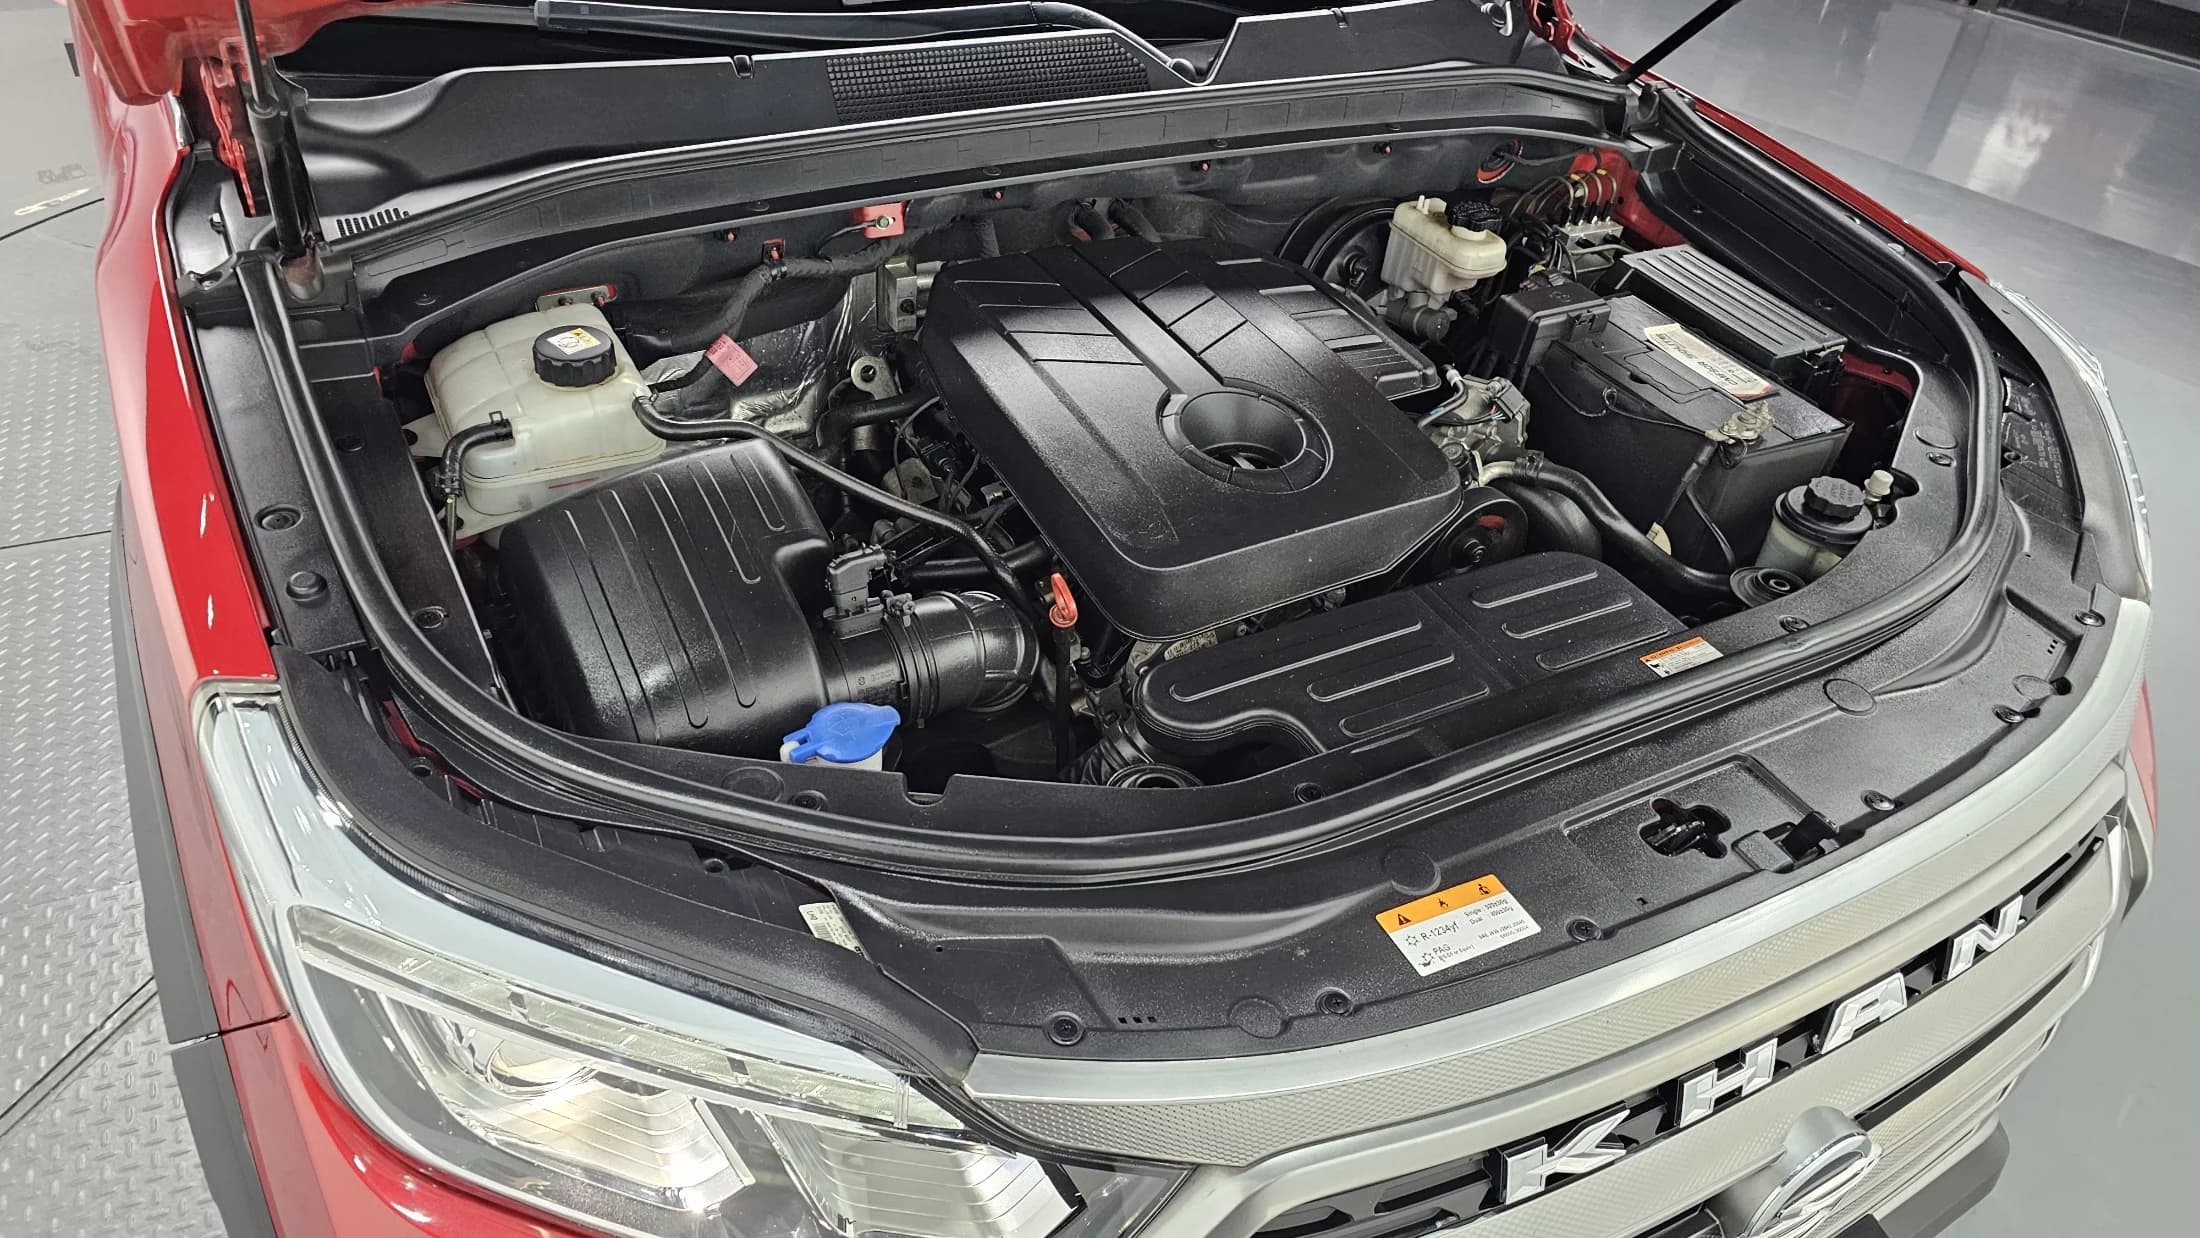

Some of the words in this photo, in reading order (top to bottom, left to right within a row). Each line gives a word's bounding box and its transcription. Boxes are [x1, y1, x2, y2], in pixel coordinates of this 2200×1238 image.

[1420, 920, 1459, 941] R-1234yf
[1432, 943, 1451, 955] PAG
[1504, 894, 2024, 1206] KHAN
